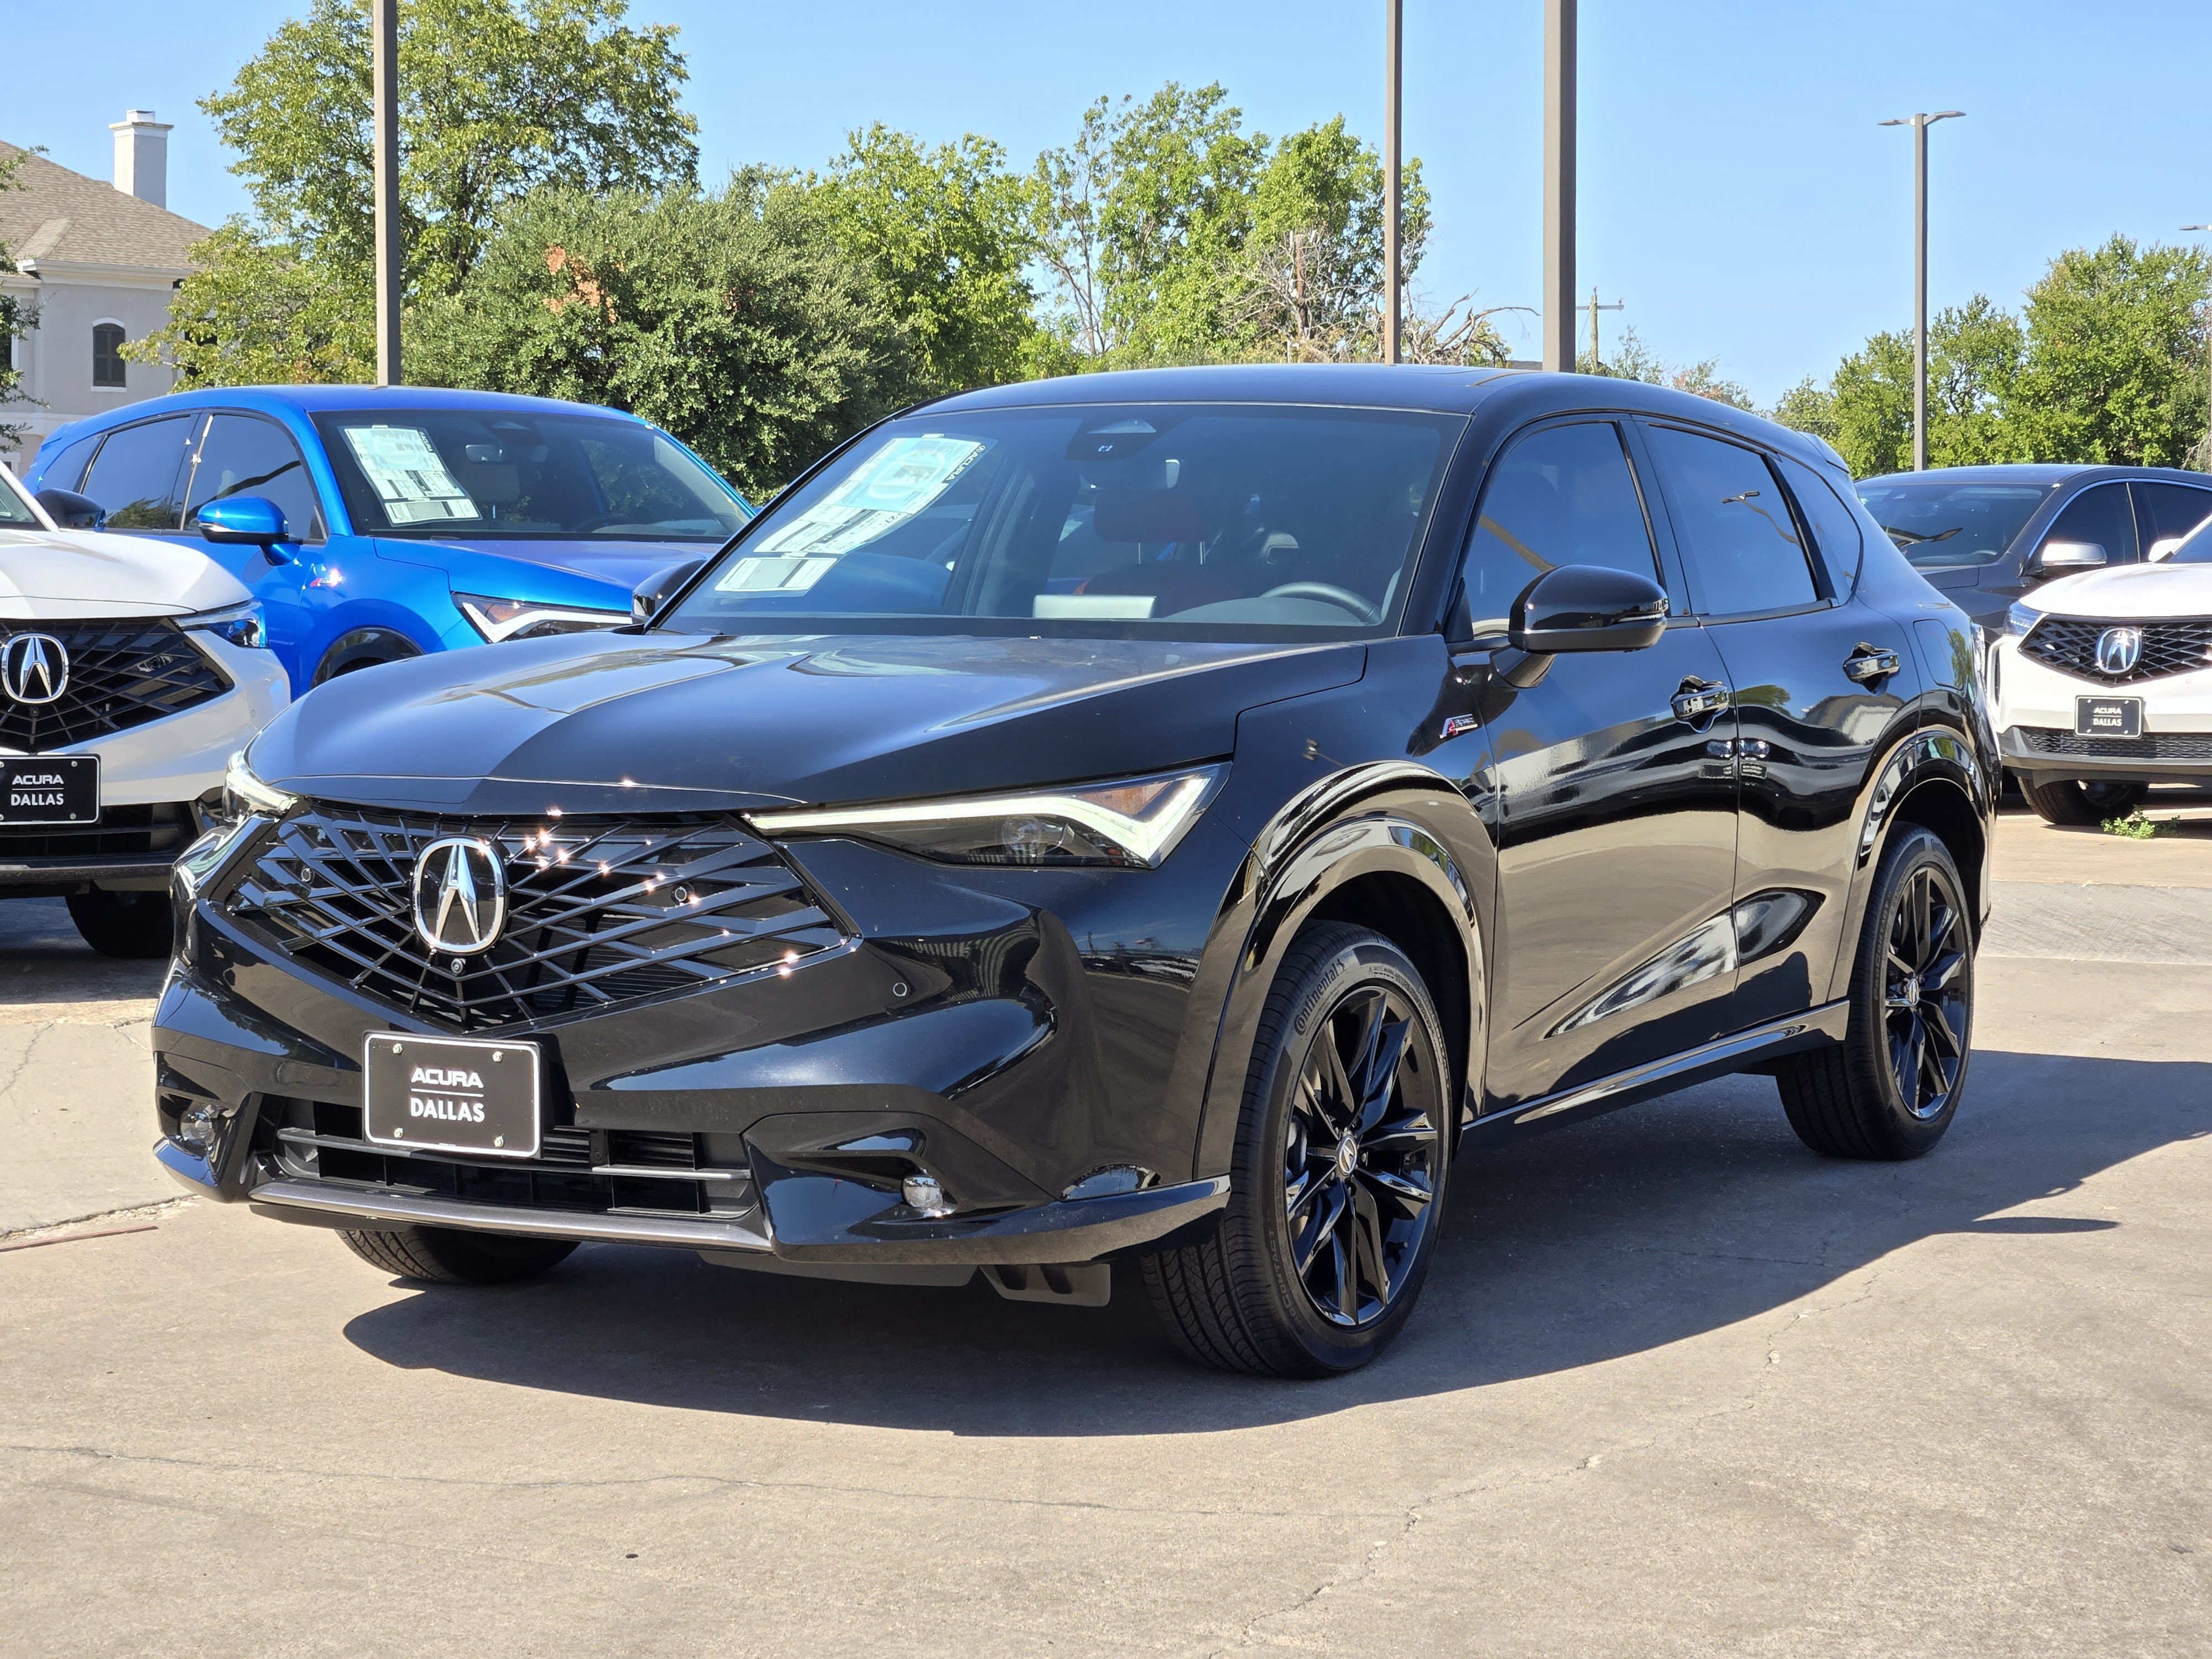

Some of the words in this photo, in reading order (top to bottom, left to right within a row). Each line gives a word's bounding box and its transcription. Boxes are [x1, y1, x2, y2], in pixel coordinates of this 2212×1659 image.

[946, 451, 978, 481] ACURA
[2093, 718, 2122, 727] DALLAS
[12, 775, 64, 785] ACURA
[11, 794, 64, 806] DALLAS
[1294, 963, 1339, 1036] Continental
[411, 1067, 484, 1088] ACURA
[410, 1097, 485, 1123] DALLAS
